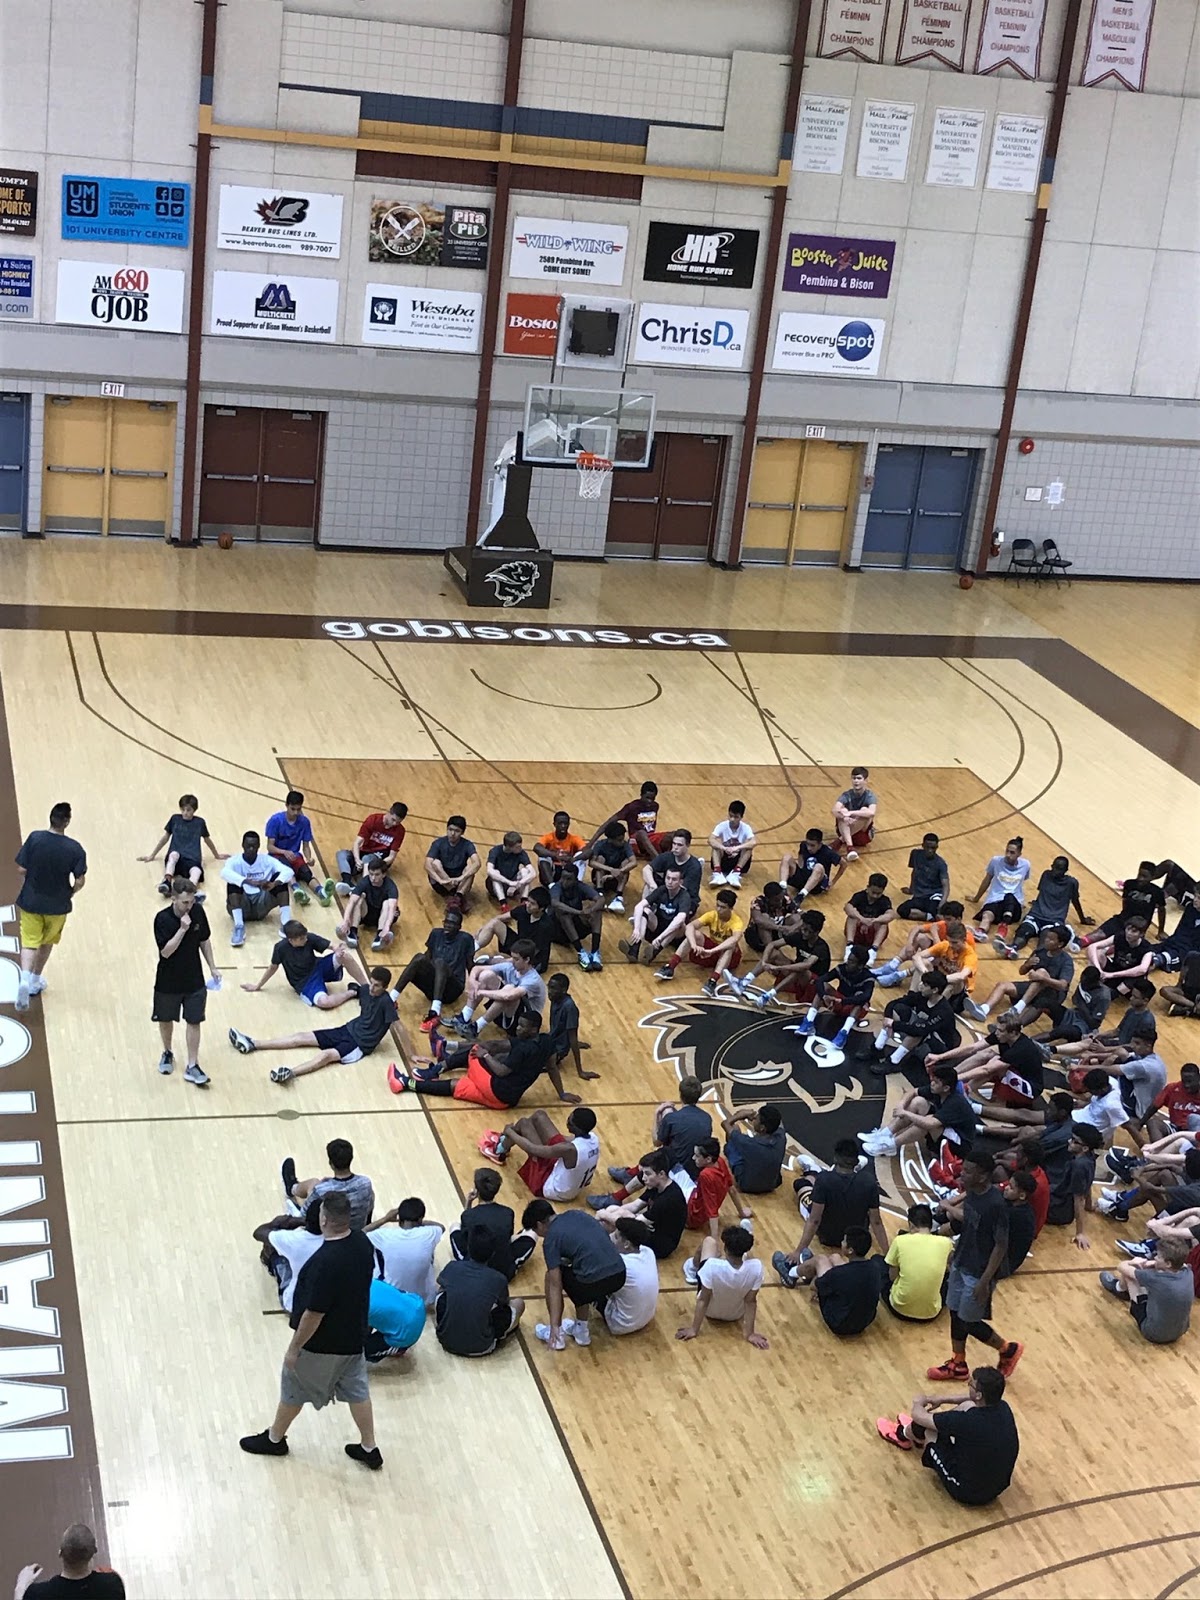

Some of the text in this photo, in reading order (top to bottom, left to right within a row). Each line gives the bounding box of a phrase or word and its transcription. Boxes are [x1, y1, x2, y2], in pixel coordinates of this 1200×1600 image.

[913, 0, 962, 12] BASKETBALL
[994, 6, 1034, 18] BASKETBALL
[1112, 6, 1133, 16] MEN'S
[1101, 19, 1140, 31] BASKETBALL
[830, 33, 874, 46] CHAMPIONS
[911, 35, 955, 48] CHAMPIONS
[990, 42, 1030, 54] CHAMPIONS
[1096, 54, 1134, 66] CHAMPIONS
[805, 105, 822, 113] HALL
[828, 107, 845, 115] FAME
[869, 111, 886, 119] HALL
[891, 113, 908, 121] FAME
[940, 119, 957, 127] HALL
[15, 189, 25, 200] OF
[109, 209, 135, 217] UNION
[453, 210, 485, 224] Pita
[84, 226, 141, 237] UNIVERSITY
[145, 230, 183, 240] CENTRE
[282, 229, 302, 237] LINES
[457, 223, 480, 236] Pit
[225, 239, 333, 252] www.beaverbus.com 989-7007
[524, 233, 614, 254] WILD WING
[682, 234, 720, 263] HR
[10, 261, 31, 270] Suites
[791, 248, 889, 271] Booster Juice
[2, 271, 30, 279] HIGHWAY
[543, 265, 592, 276] COME GET SOME!
[666, 264, 734, 276] HOME RUN SPORTS
[93, 269, 149, 292] AM 680
[800, 274, 874, 290] Pembina & Bison
[91, 294, 148, 323] CJOB
[411, 300, 476, 317] Westoba
[256, 310, 296, 320] MULTICRETE
[216, 318, 232, 327] Proud
[233, 320, 258, 330] Supporter
[259, 321, 265, 329] of
[266, 322, 280, 330] Bison
[304, 325, 331, 334] Basketball
[442, 324, 473, 333] Community
[509, 315, 558, 330] Bosto
[661, 345, 691, 353] WINNIPEG
[103, 383, 122, 396] EXIT
[808, 426, 823, 437] EXIT
[322, 620, 731, 647] gobisons.ca
[579, 1164, 597, 1188] 12
